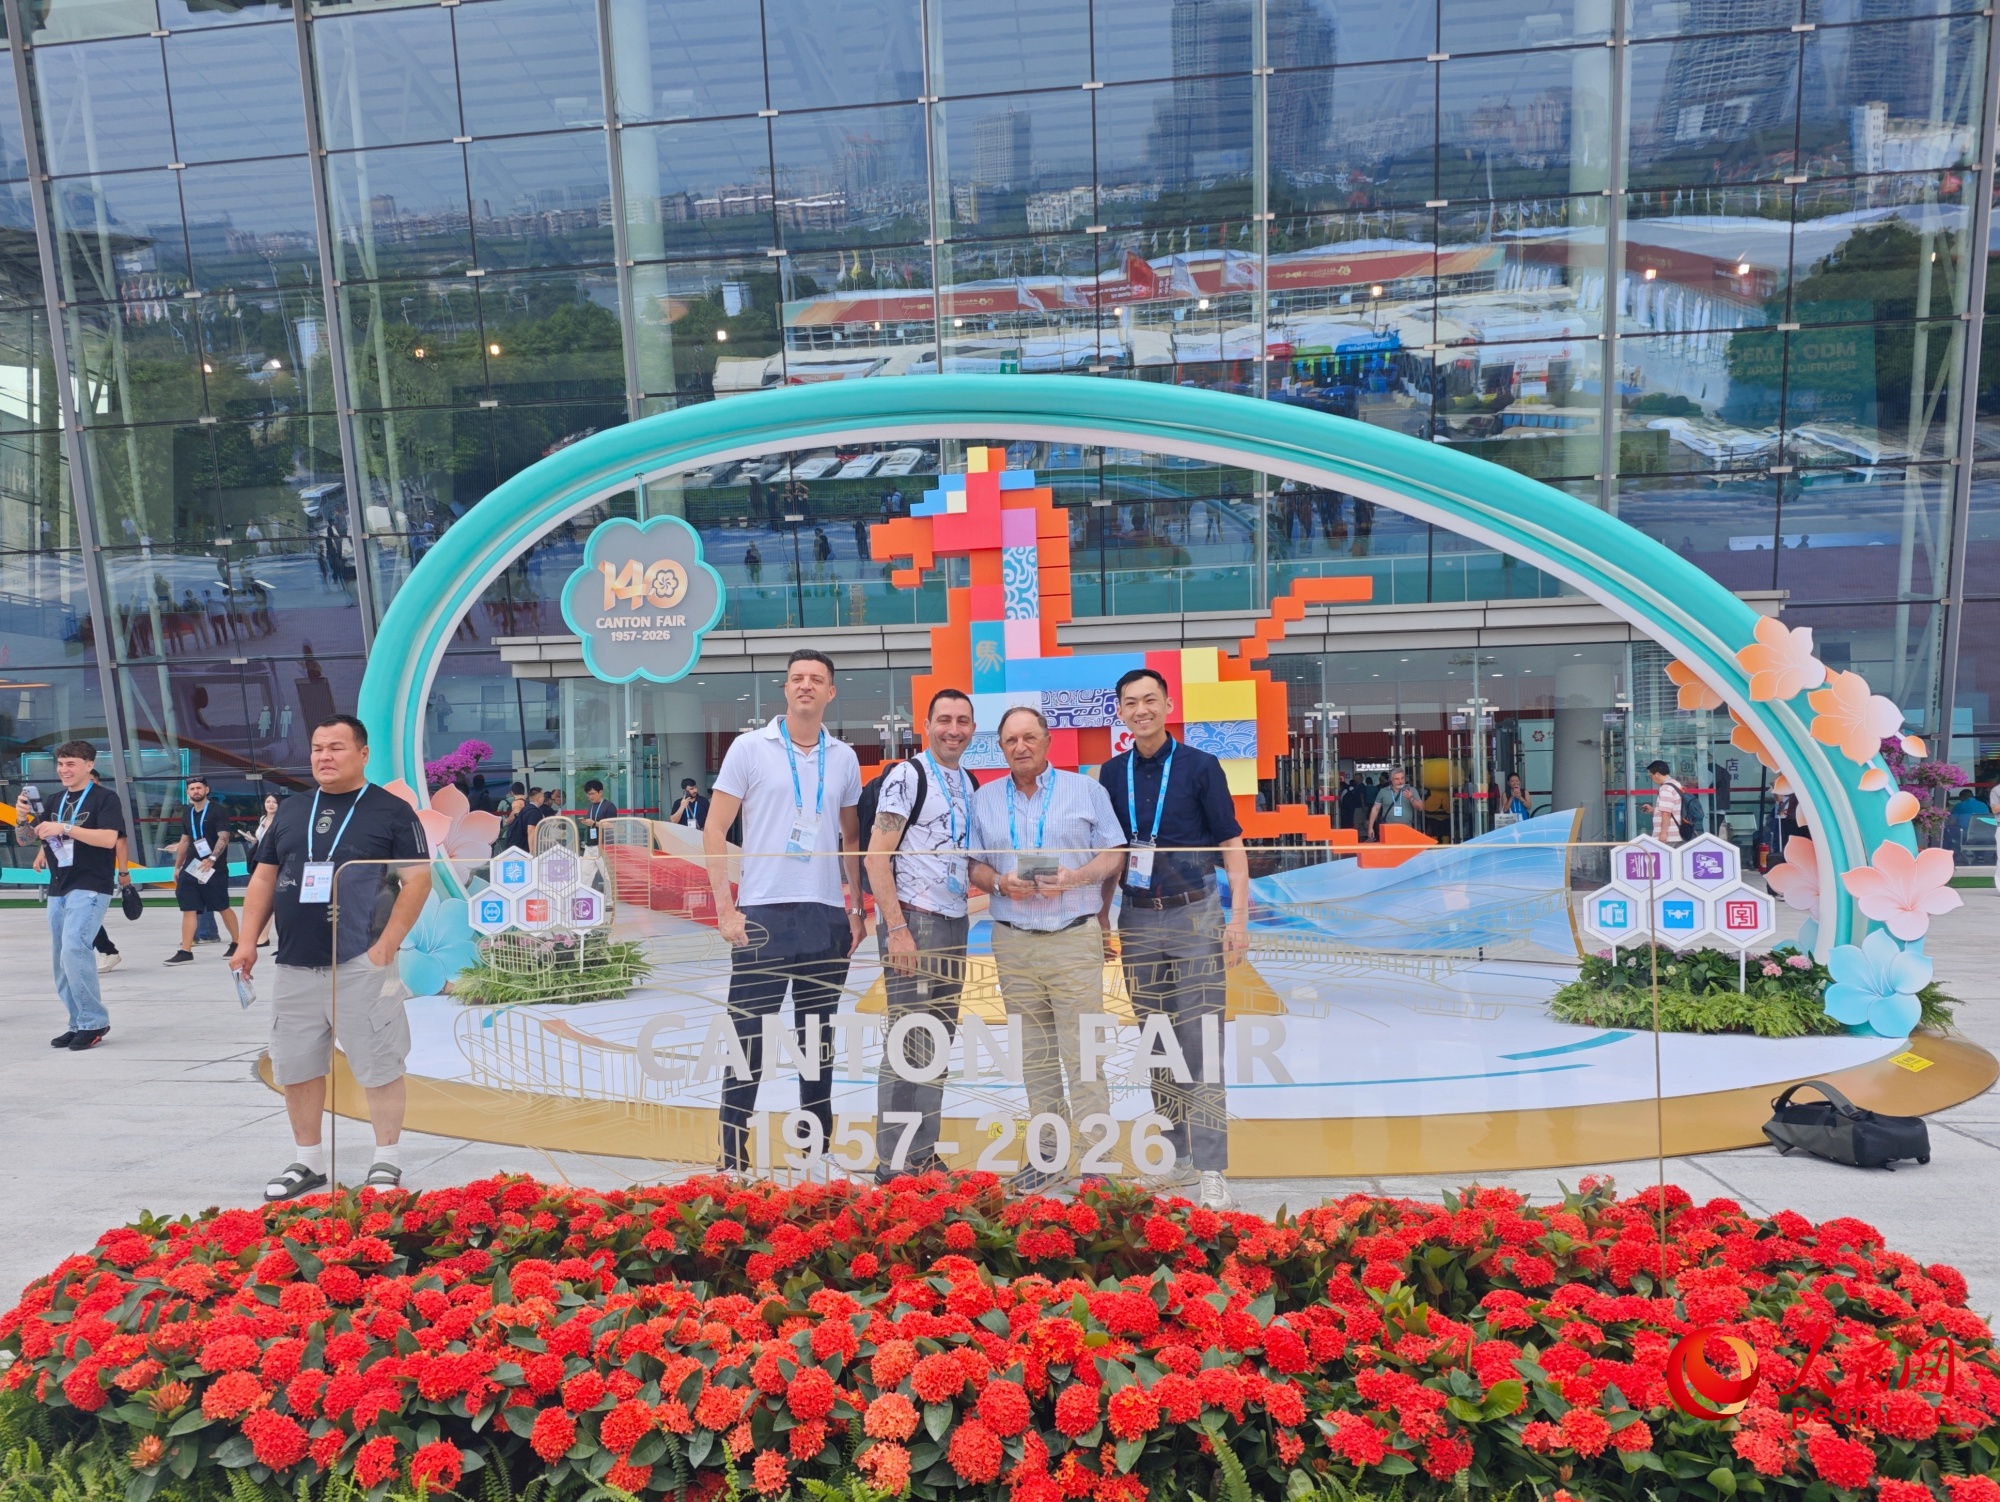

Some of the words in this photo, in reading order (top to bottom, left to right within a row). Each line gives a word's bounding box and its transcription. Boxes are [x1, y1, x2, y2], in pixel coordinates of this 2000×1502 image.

[1803, 342, 1857, 360] ODM
[1799, 360, 1857, 374] DIFFUSER
[598, 559, 688, 611] 140
[596, 616, 651, 629] CANTON
[656, 615, 687, 627] FAIR
[611, 630, 671, 642] 1957-2026
[637, 1013, 1023, 1083] CANTON
[1078, 1013, 1296, 1085] FAIR
[746, 1110, 1177, 1176] 1957-2026
